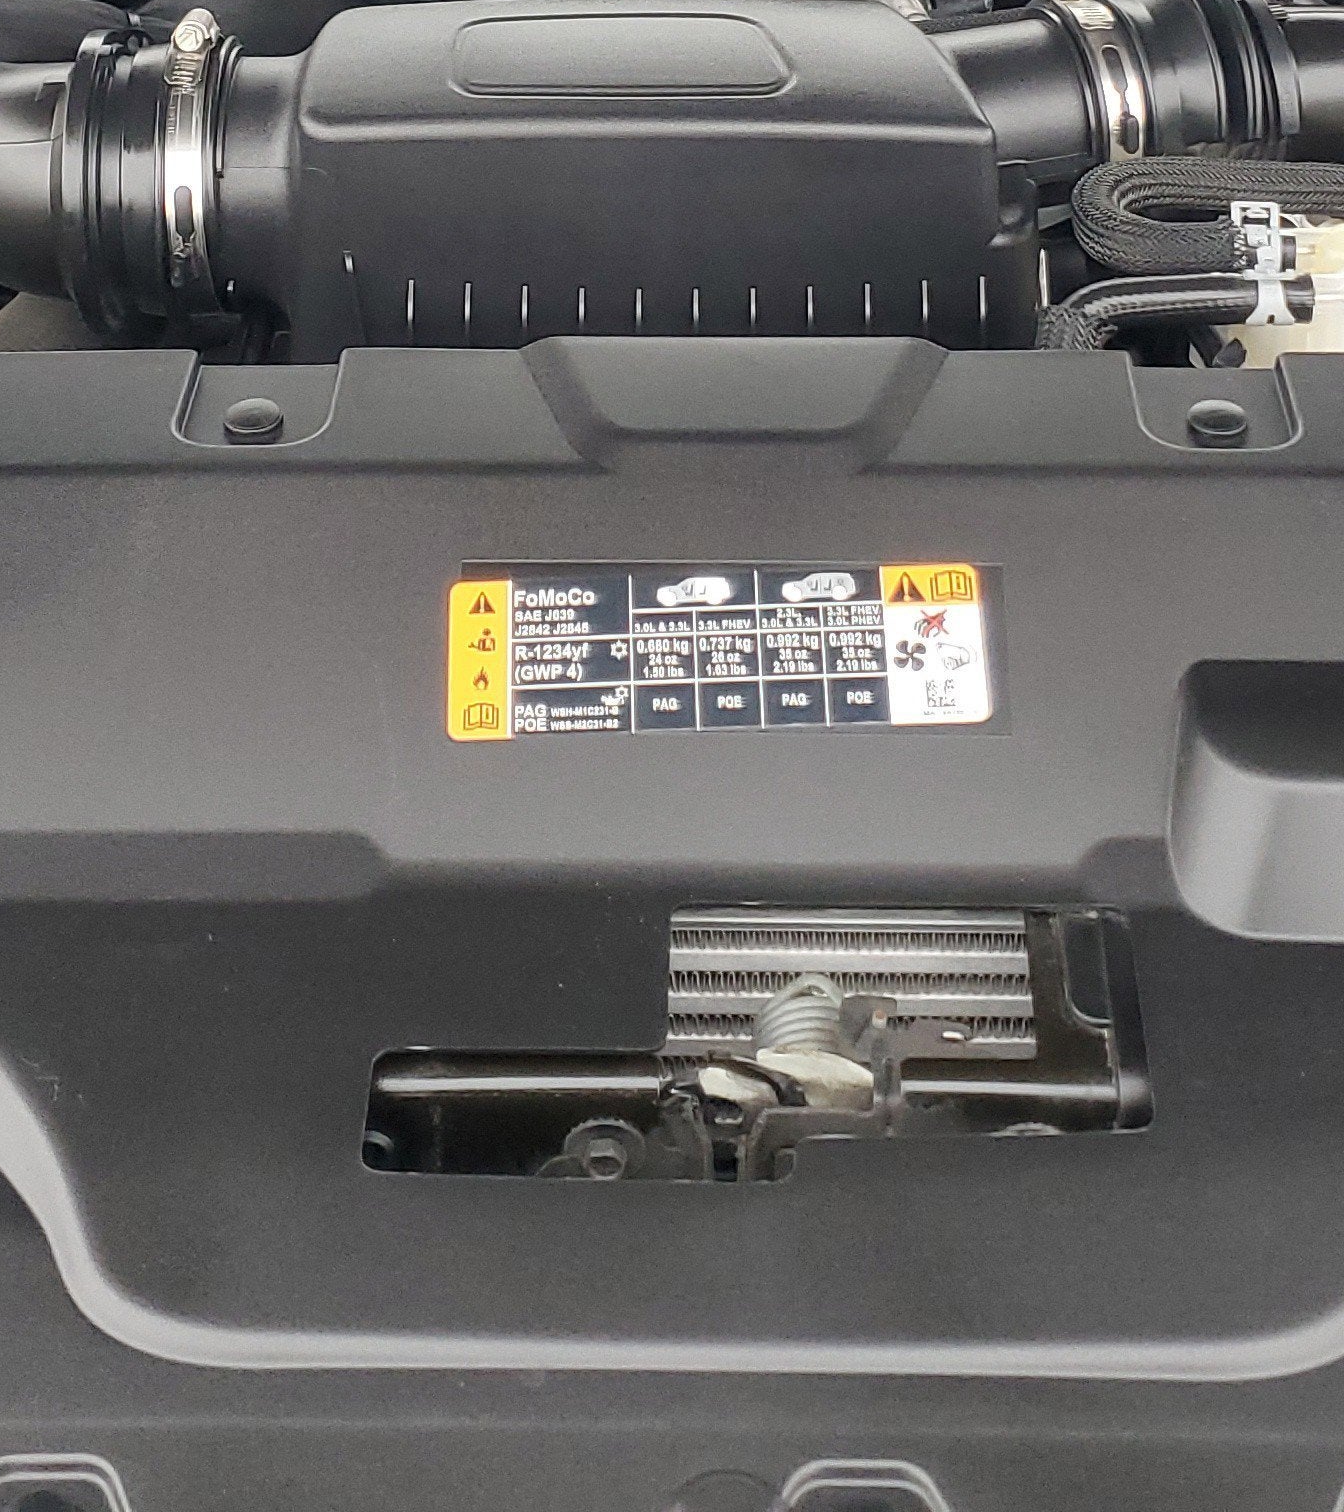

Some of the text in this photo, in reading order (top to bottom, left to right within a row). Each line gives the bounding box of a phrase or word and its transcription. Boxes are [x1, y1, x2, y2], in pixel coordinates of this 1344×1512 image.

[514, 588, 596, 607] FoMoCo
[515, 610, 542, 622] SAE
[761, 616, 818, 628] 3.0L & 3.3L
[827, 616, 849, 626] 3.0L
[635, 620, 690, 632] 3.0L & 3.3L
[698, 619, 719, 630] 3.3L
[699, 636, 752, 653] 0.737 kg
[766, 632, 819, 650] 0.992 kg
[828, 631, 882, 648] 0.992 kg
[515, 642, 589, 661] R-1234yf
[636, 638, 689, 655] 0.680 kg
[841, 646, 871, 659] 35 oz
[648, 653, 679, 666] 24 oz
[711, 651, 741, 663] 26 oz
[794, 649, 808, 660] oz
[643, 666, 684, 678] 1.50 lbs
[705, 663, 747, 676] 1.63 lbs
[773, 660, 815, 673] 2.19 lbs
[836, 659, 878, 672] 2.19 lbs
[515, 662, 583, 684] (GWP 4)
[652, 697, 678, 711] PAG
[717, 695, 743, 709] POE
[781, 692, 807, 706] PAG
[846, 691, 872, 704] POE
[515, 704, 547, 718] PAG
[515, 717, 547, 732] POE
